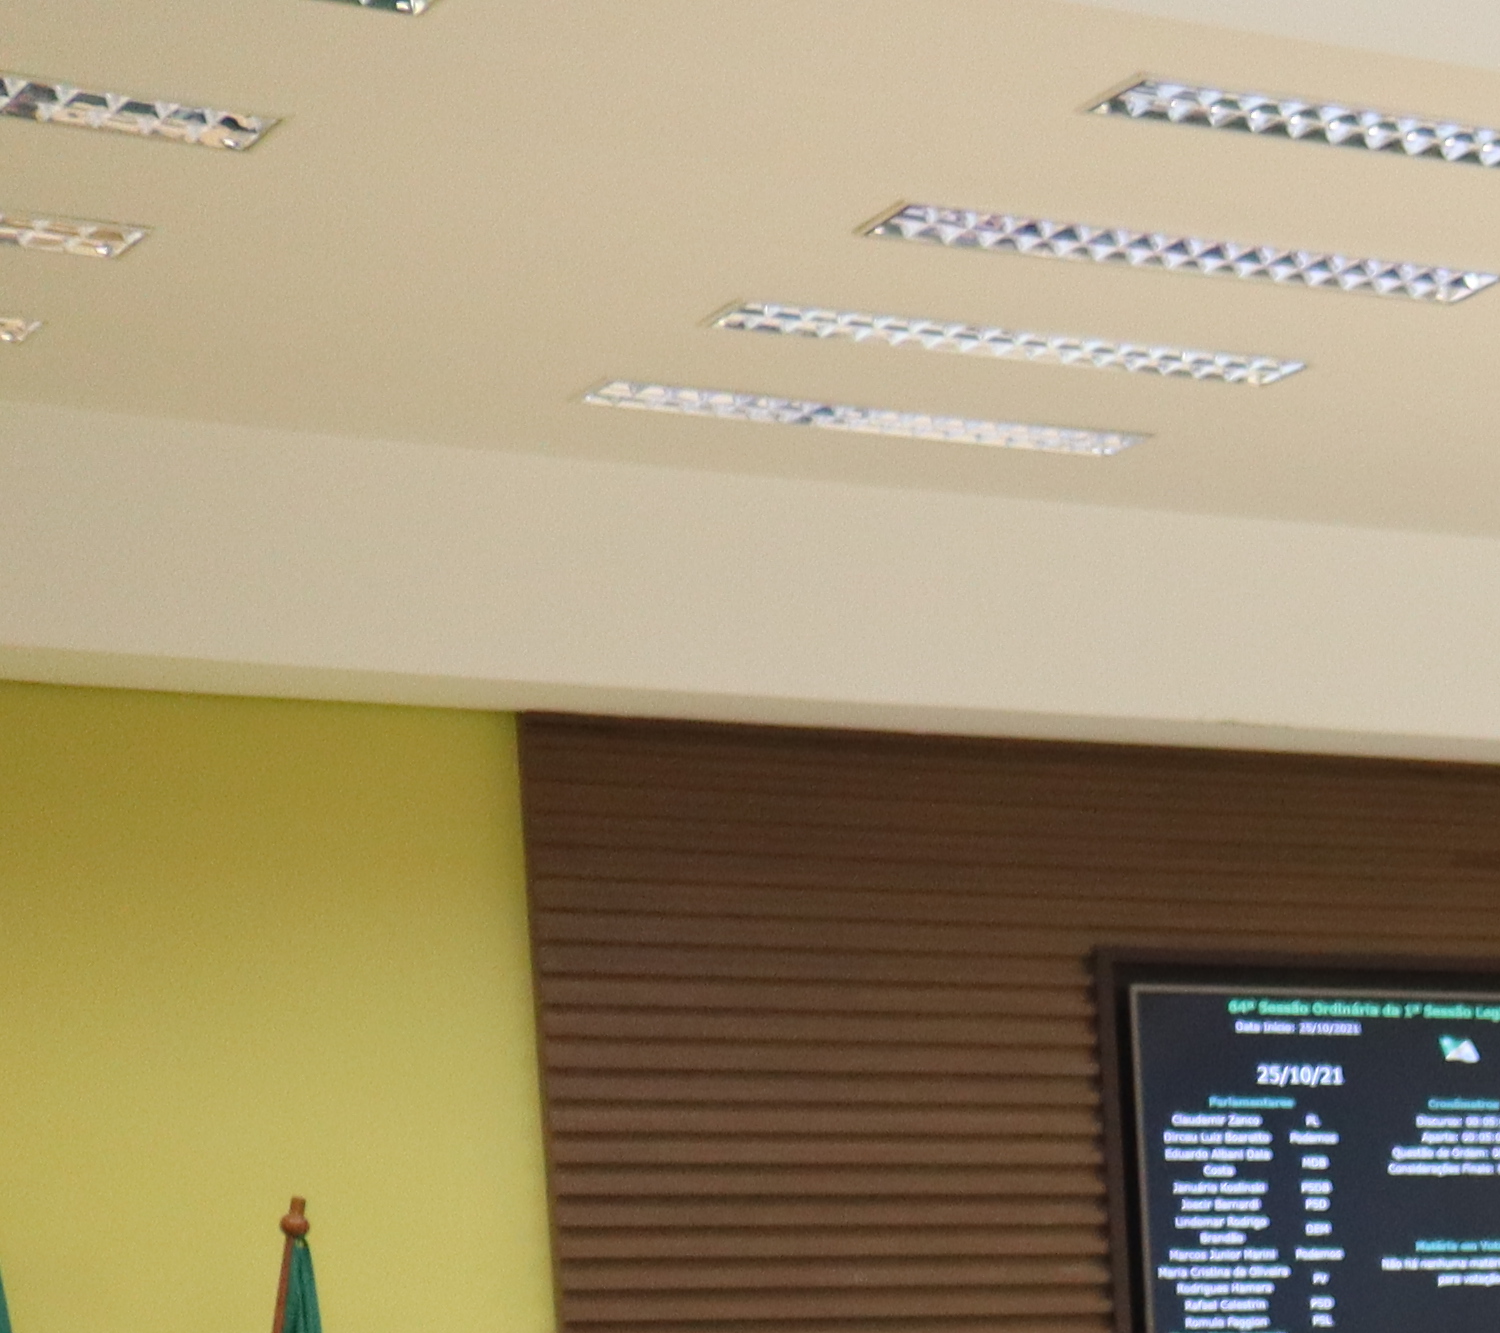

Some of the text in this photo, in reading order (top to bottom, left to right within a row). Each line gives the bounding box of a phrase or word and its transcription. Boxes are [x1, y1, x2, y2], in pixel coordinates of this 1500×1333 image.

[1258, 999, 1309, 1016] Sessão
[1311, 1000, 1380, 1017] Ordinária
[1381, 1002, 1402, 1017] da
[1423, 1002, 1472, 1019] Sessão
[1235, 1020, 1262, 1033] Data
[1299, 1021, 1362, 1036] 25/10/2021
[1257, 1063, 1344, 1087] 25/10/21
[1302, 1154, 1330, 1170] MDB
[1305, 1221, 1332, 1236] DEM
